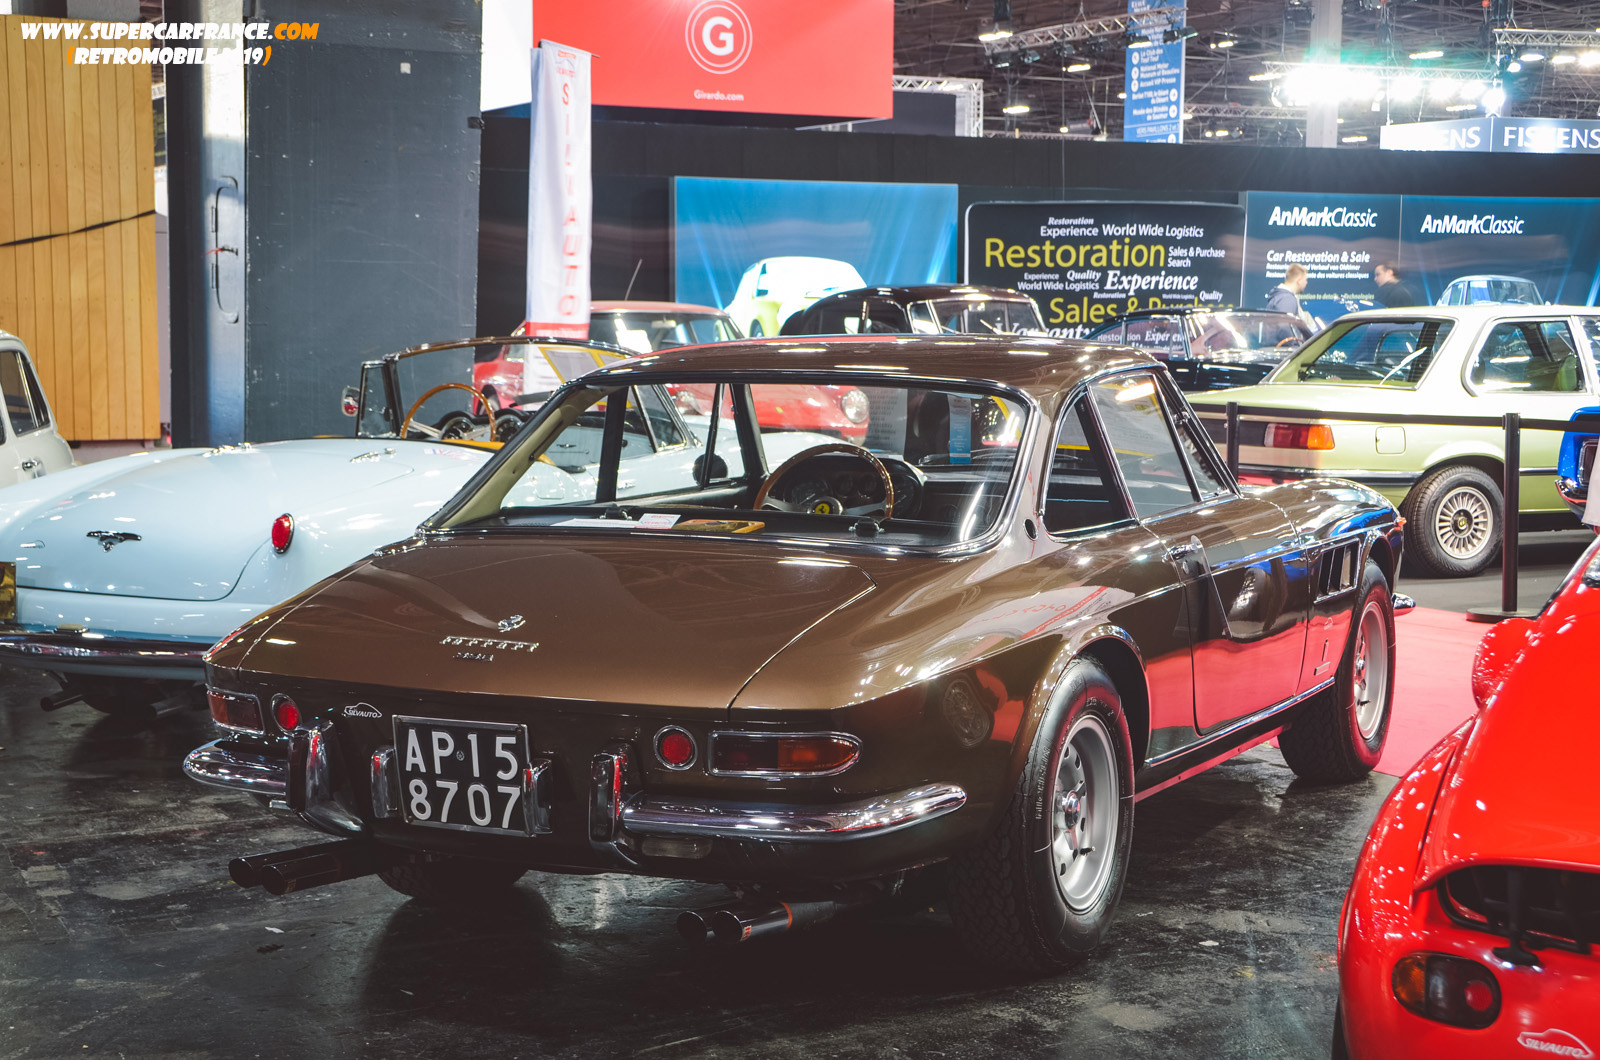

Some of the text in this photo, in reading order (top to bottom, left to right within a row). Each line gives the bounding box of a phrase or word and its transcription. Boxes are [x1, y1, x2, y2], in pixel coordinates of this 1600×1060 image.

[702, 16, 734, 56] G
[694, 89, 744, 102] Girardo.com
[1504, 126, 1600, 149] FISENS
[1048, 216, 1094, 226] Restoration
[1268, 206, 1378, 228] AnMarkClassic
[1420, 214, 1524, 234] AnMarkClassic
[1040, 224, 1204, 240] Experience World Wide Logistics
[985, 237, 1165, 268] Restoration
[1168, 246, 1226, 258] Sales & Purchase
[1266, 250, 1370, 263] Car Restoration & Sale
[1168, 258, 1191, 268] Search
[1024, 270, 1102, 282] Experience Quality
[1104, 270, 1198, 296] Experience
[1018, 281, 1100, 292] World Wide Logistics
[1200, 290, 1223, 302] Quality
[1049, 296, 1118, 324] Sales
[995, 322, 1095, 340] aanty
[1098, 330, 1185, 345] Restotion Experen
[348, 708, 378, 718] SILVAUTO
[409, 778, 520, 829] 8707
[1524, 1038, 1584, 1058] SILVAUTO
